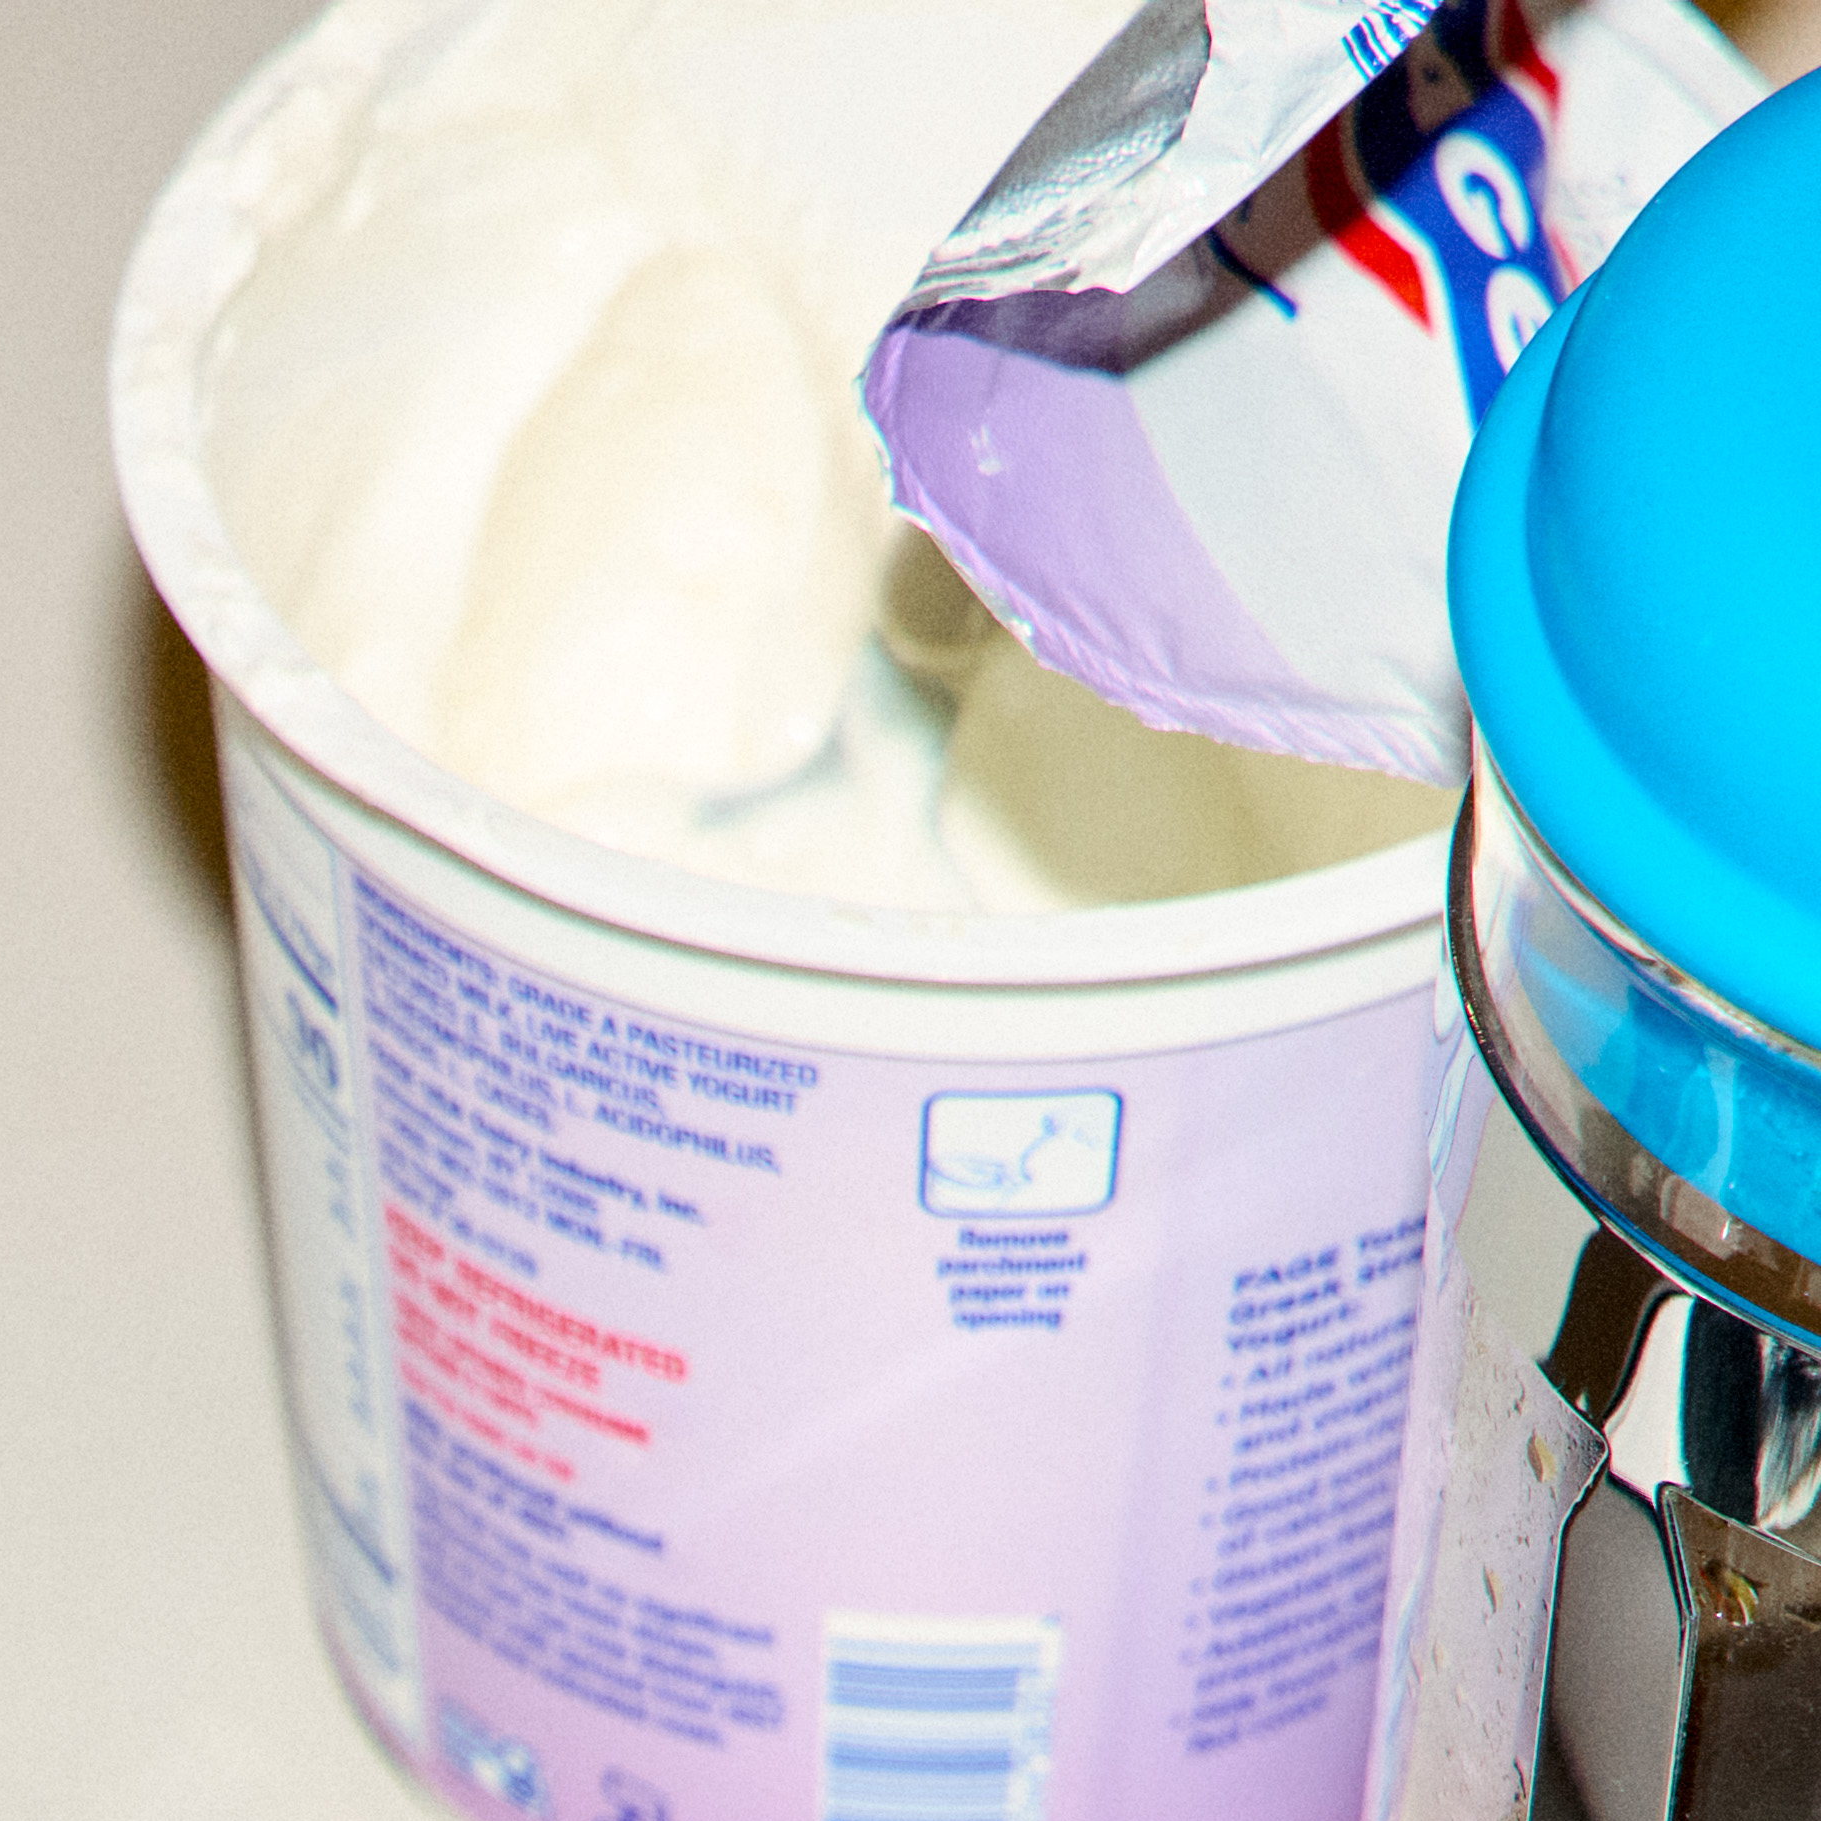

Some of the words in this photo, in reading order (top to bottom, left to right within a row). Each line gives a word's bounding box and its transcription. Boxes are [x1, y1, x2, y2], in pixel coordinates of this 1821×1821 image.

[507, 976, 593, 1026] GRADE
[601, 1015, 617, 1038] A
[626, 1022, 819, 1087] PASTEURIZED
[526, 1012, 578, 1050] LIVE
[587, 1041, 677, 1086] ACTIVE
[686, 1070, 798, 1117] YOGURT
[957, 1226, 1069, 1249] Remove
[935, 1250, 1086, 1280] parchment
[1232, 1244, 1340, 1295] FAGE
[948, 1284, 1026, 1308] paper
[1036, 1283, 1069, 1300] on
[952, 1309, 1062, 1333] opening
[457, 1259, 691, 1384] REFRIGERATED
[490, 1316, 603, 1392] FREEZE
